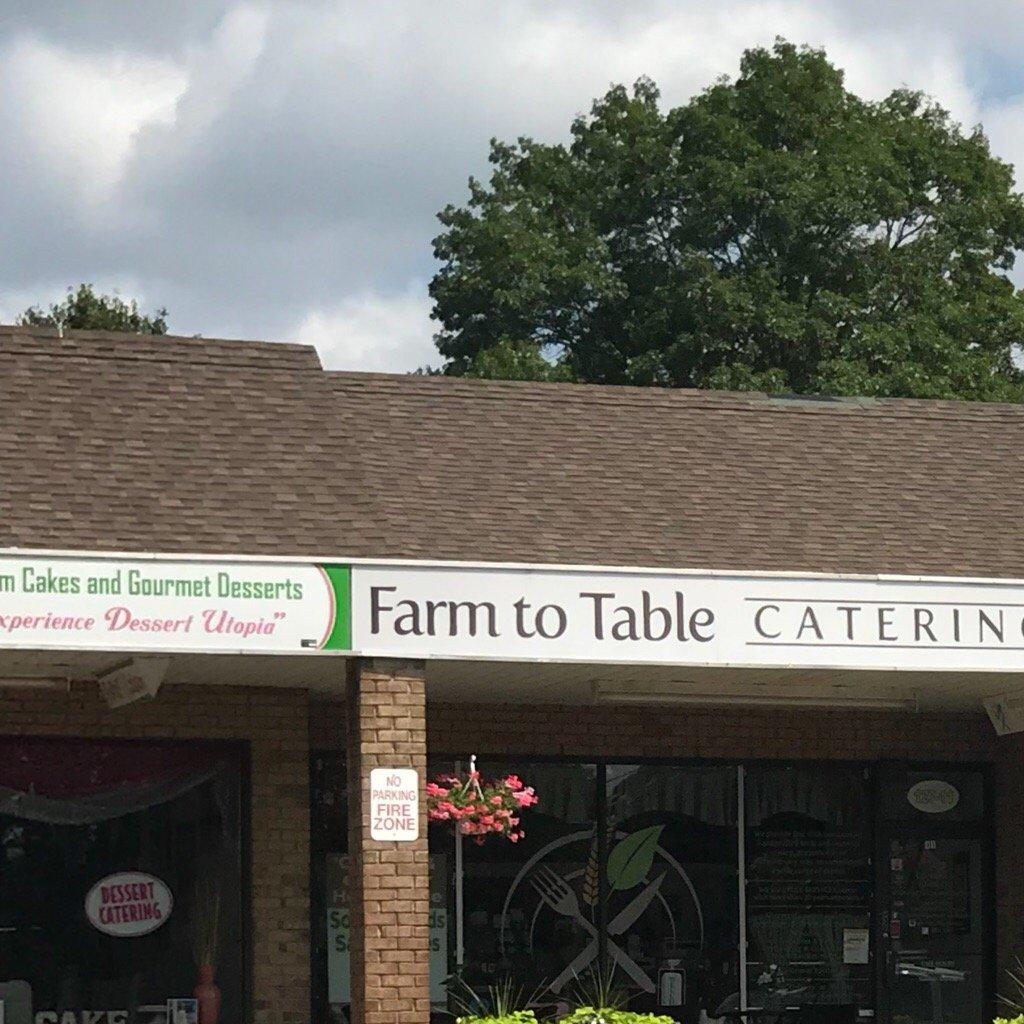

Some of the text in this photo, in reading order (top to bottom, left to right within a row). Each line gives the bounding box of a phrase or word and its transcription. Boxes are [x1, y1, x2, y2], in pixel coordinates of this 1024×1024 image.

[22, 566, 81, 594] Cakes
[87, 568, 121, 595] and
[128, 569, 211, 598] Gourmet
[217, 571, 303, 600] Desserts
[104, 606, 194, 633] Dessert
[370, 586, 501, 637] Farm
[514, 597, 567, 638] to
[579, 590, 716, 643] Table
[386, 776, 402, 787] NO
[373, 790, 416, 801] PARKING
[377, 804, 411, 816] FIRE
[373, 818, 415, 830] ZONE
[100, 881, 155, 904] DESSERT
[98, 902, 162, 925] CATERING
